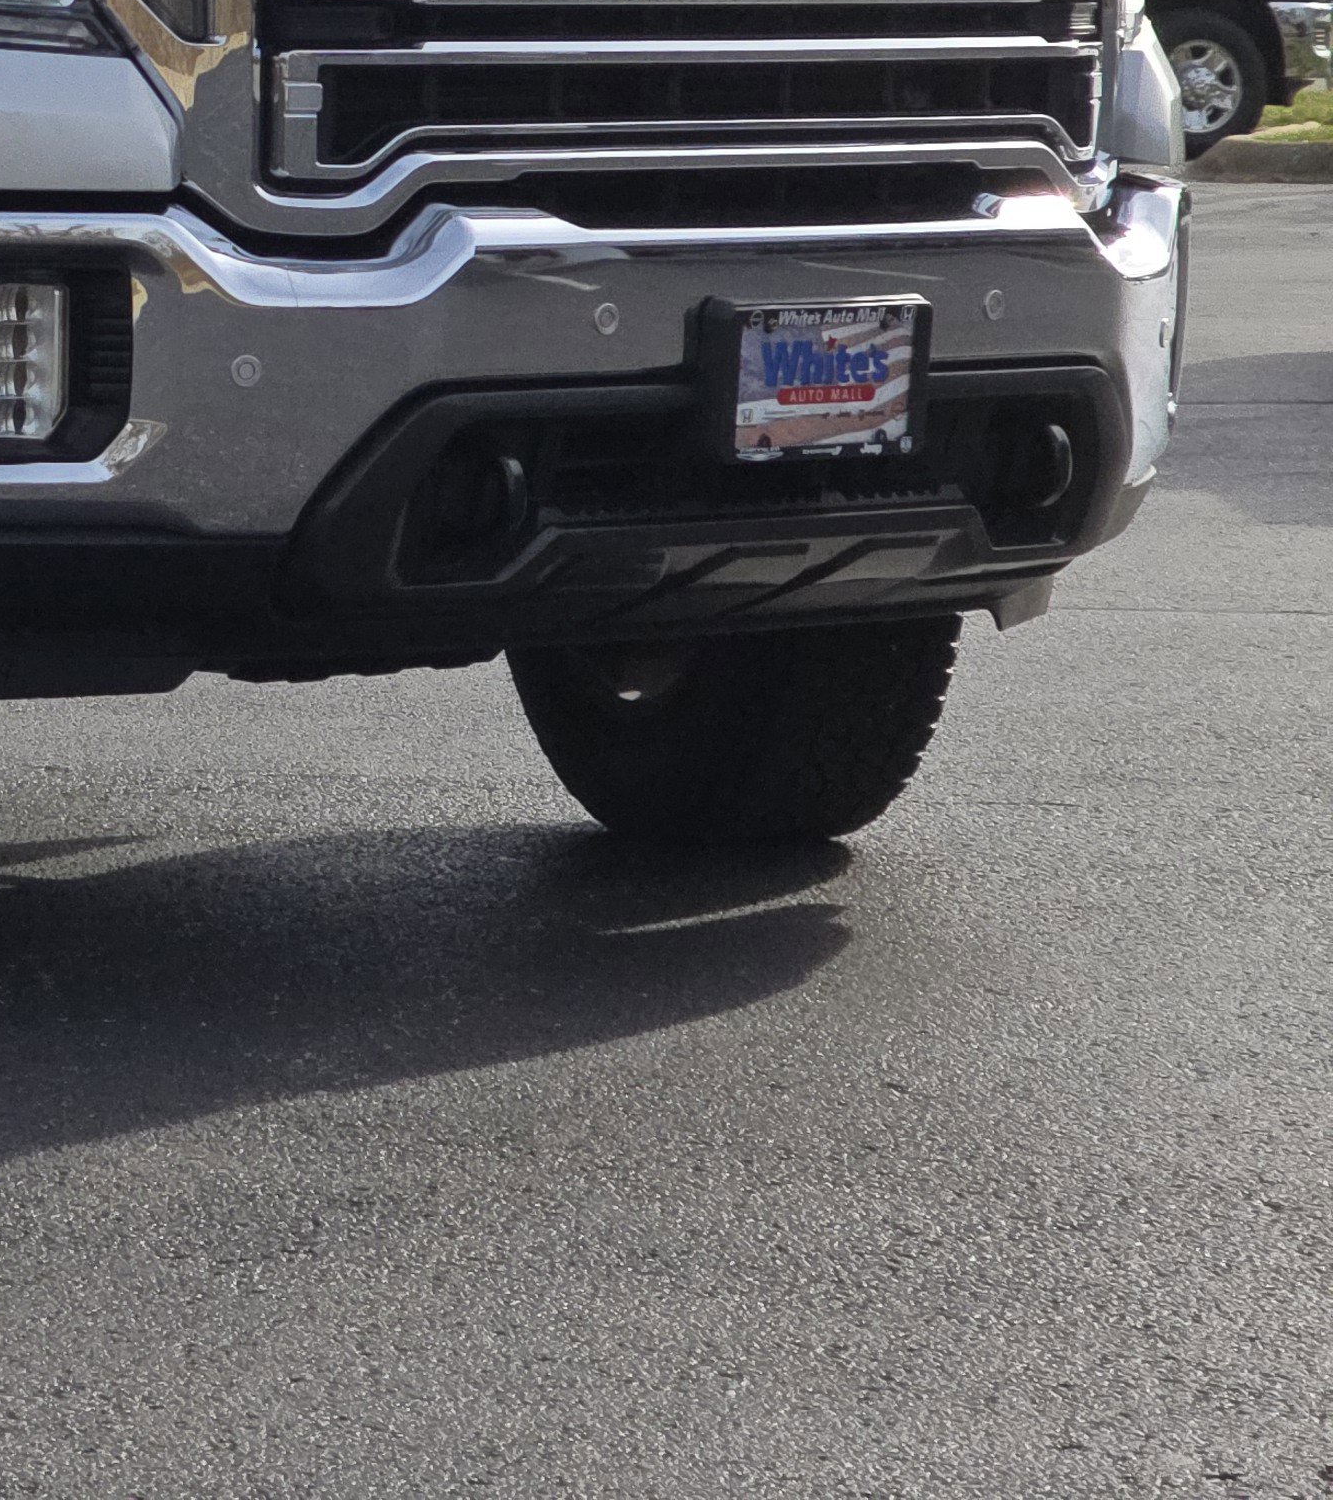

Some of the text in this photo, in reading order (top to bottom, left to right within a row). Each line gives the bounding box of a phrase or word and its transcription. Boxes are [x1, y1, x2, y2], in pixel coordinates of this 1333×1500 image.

[778, 307, 886, 326] White's Auto Mall
[761, 340, 889, 387] White's
[789, 388, 864, 403] AUTO MALL
